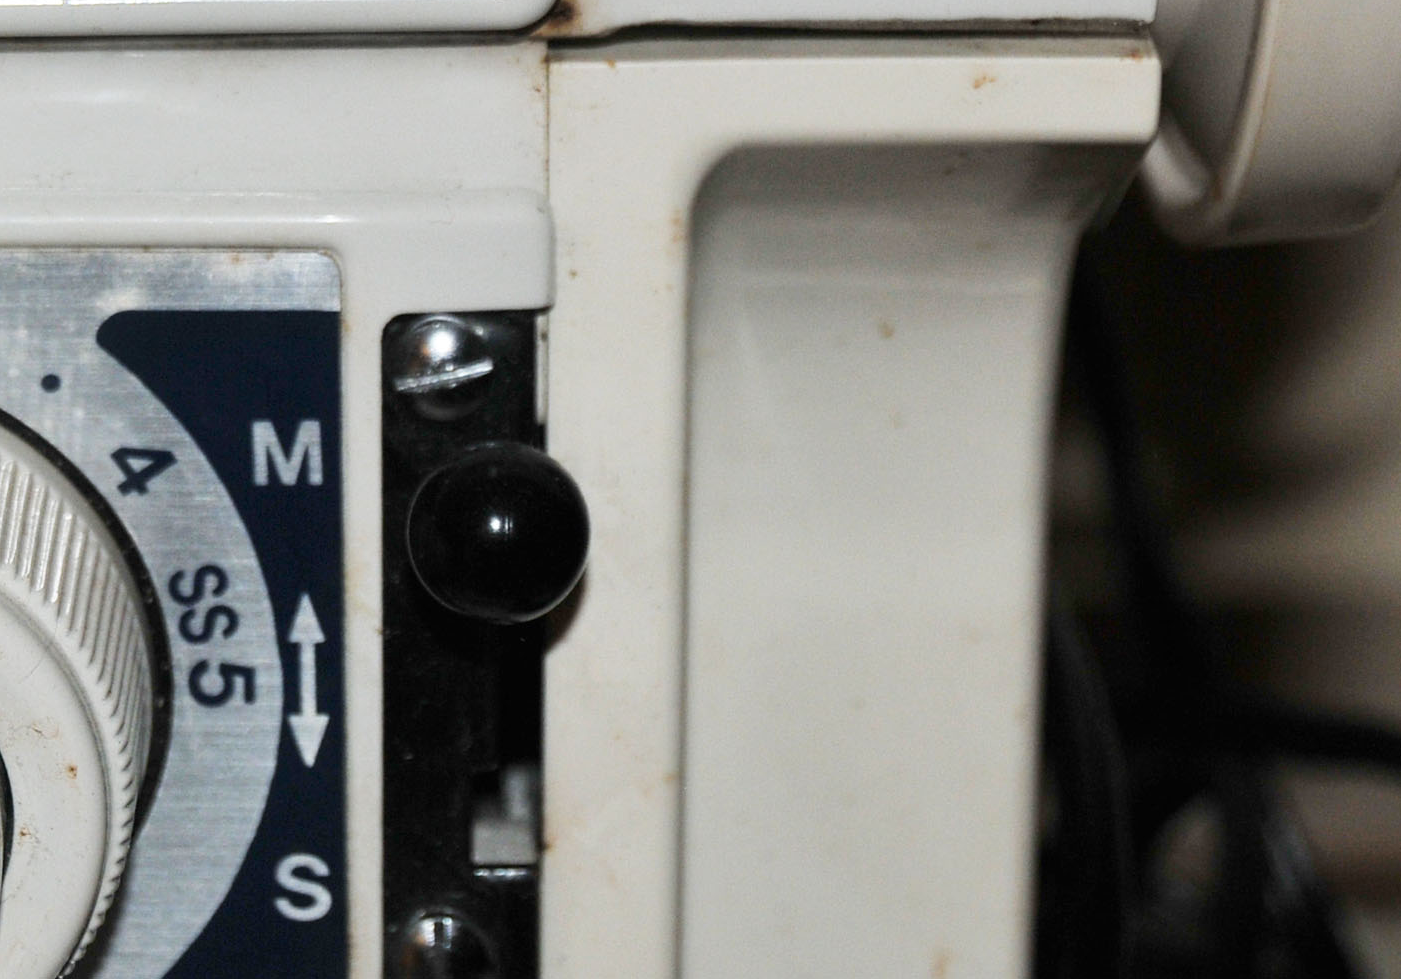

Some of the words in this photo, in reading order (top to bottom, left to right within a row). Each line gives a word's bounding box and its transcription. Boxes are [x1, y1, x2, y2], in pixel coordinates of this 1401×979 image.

[110, 446, 178, 496] 4
[252, 420, 323, 487] M
[274, 853, 333, 920] S
